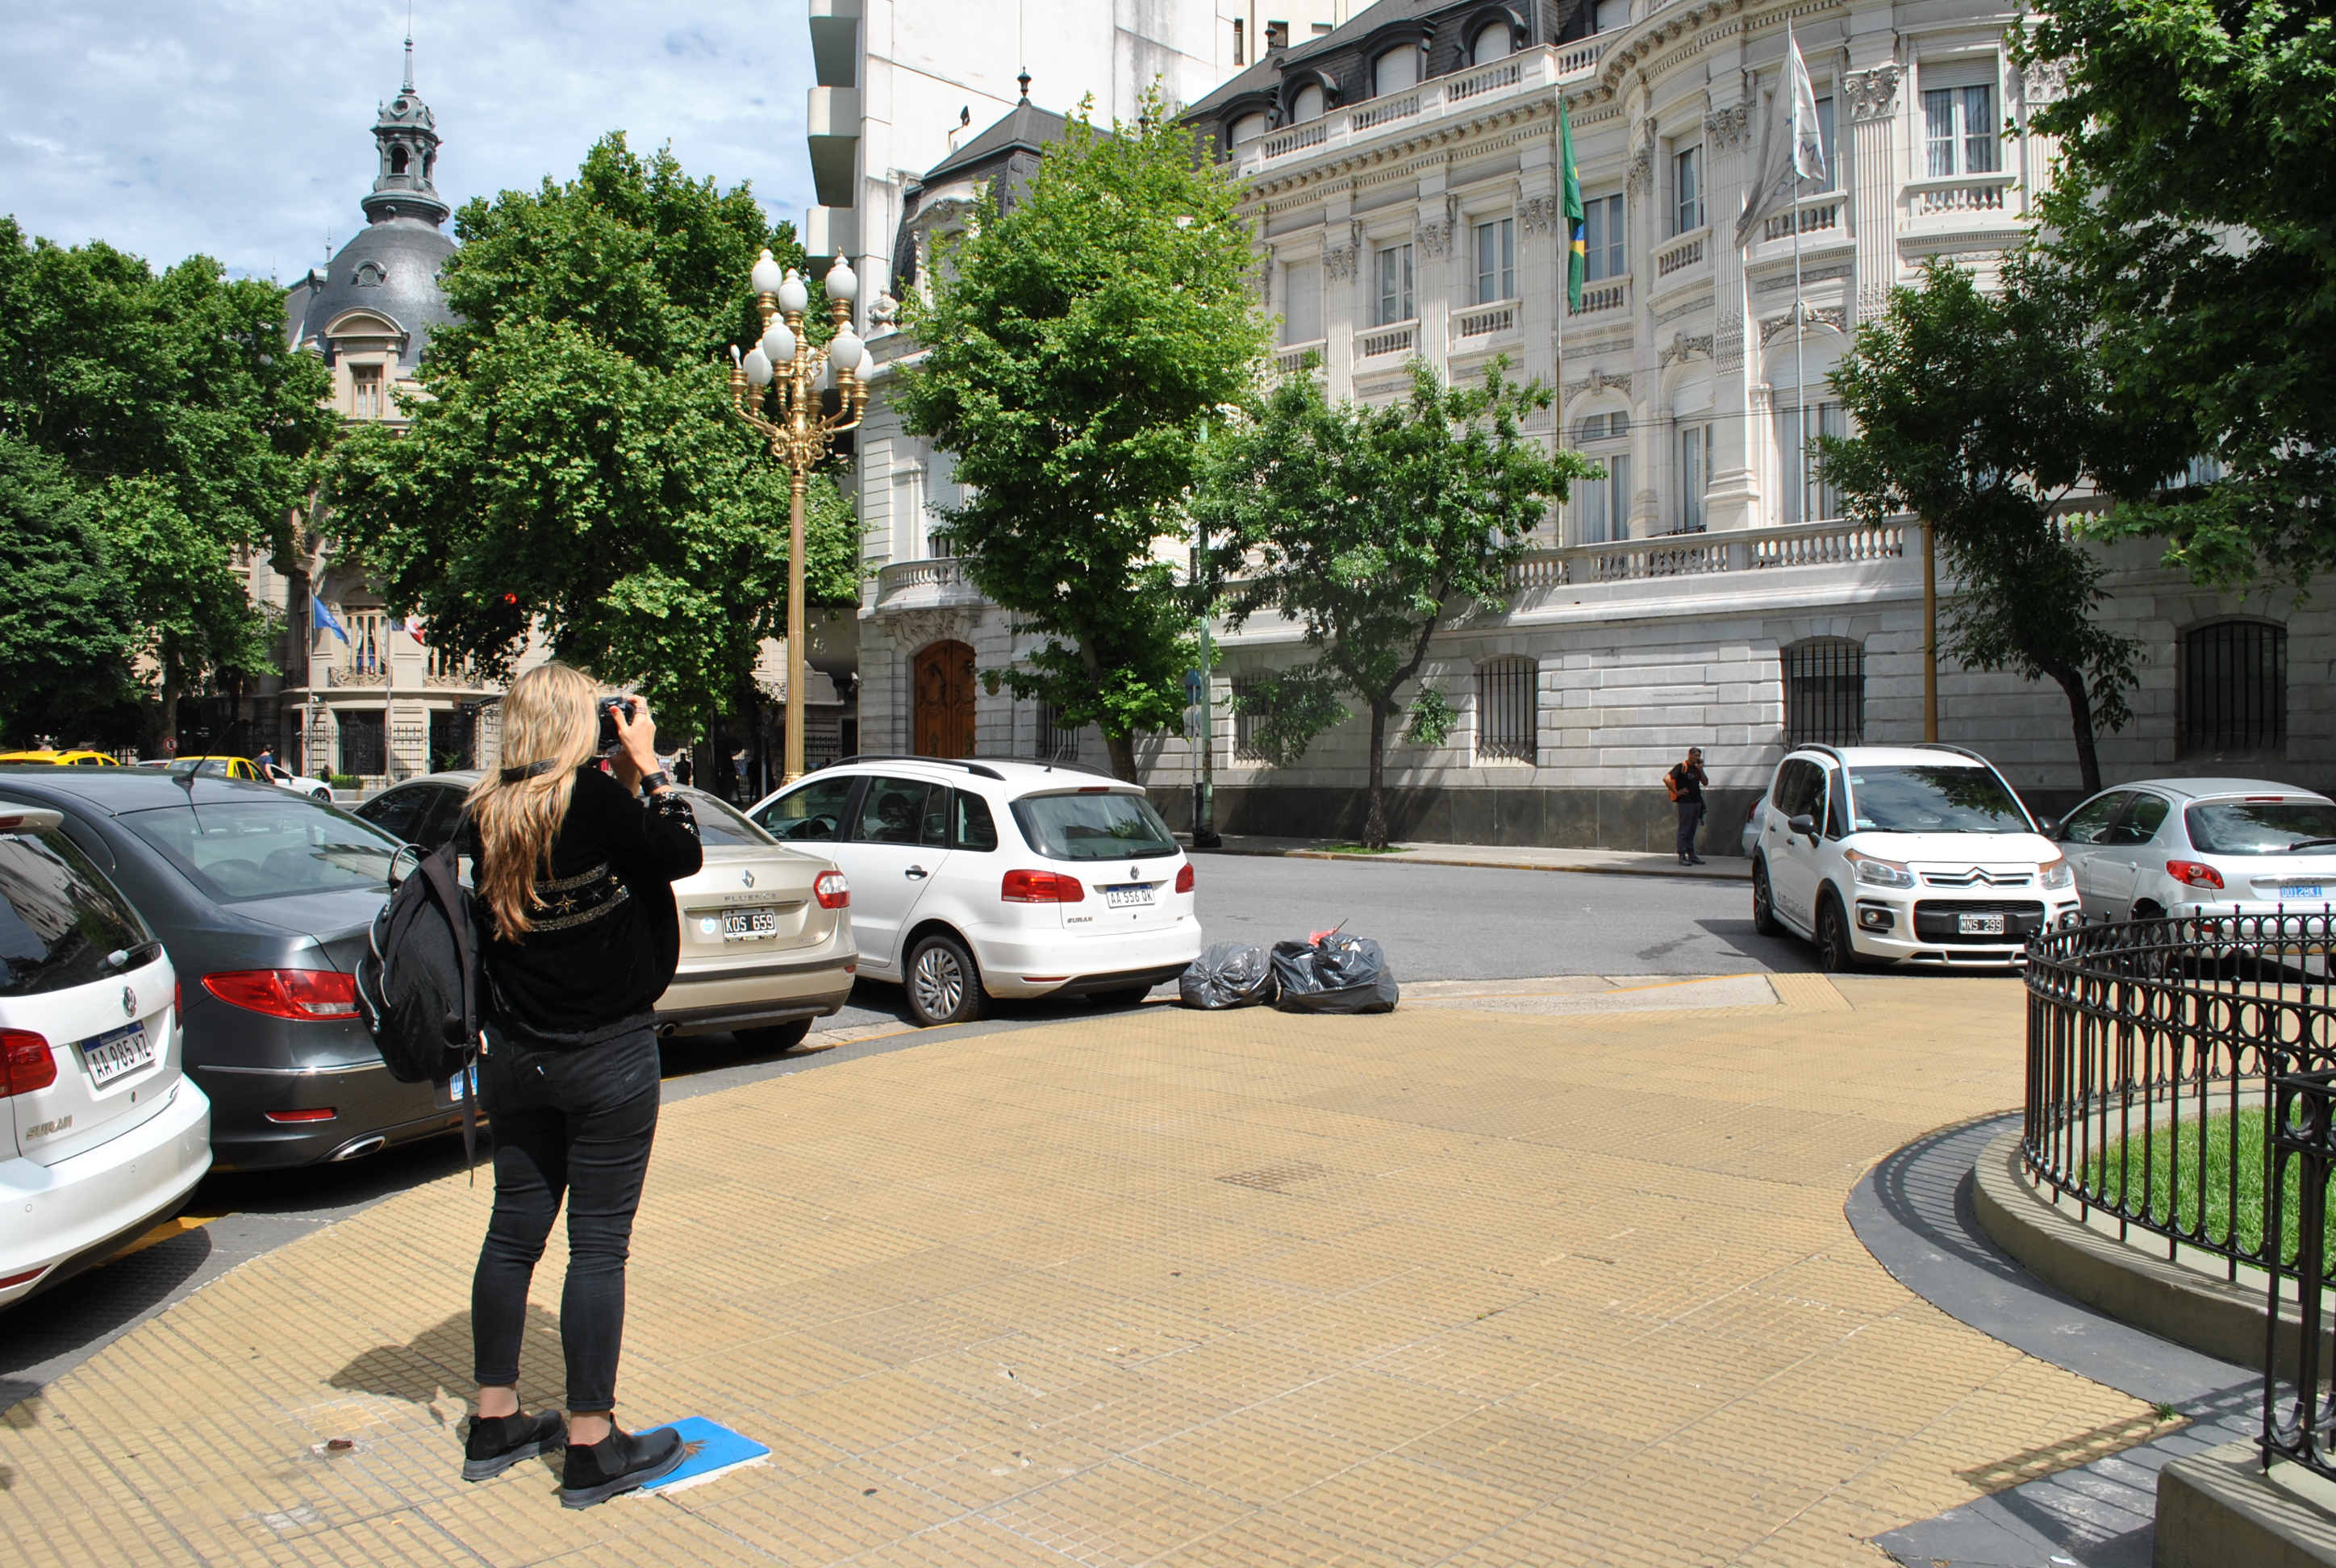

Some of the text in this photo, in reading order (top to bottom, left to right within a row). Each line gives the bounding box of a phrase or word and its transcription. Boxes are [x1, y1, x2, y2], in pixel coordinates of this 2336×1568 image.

[724, 893, 778, 903] FLUENCE
[1111, 889, 1153, 905] AA 556 QK
[724, 916, 748, 933] KOS
[752, 914, 775, 931] 659
[1960, 920, 2001, 931] MNS 299
[91, 1050, 113, 1078] AA
[108, 1039, 136, 1070] 985
[131, 1033, 152, 1061] XZ
[26, 1115, 73, 1141] SURAN
